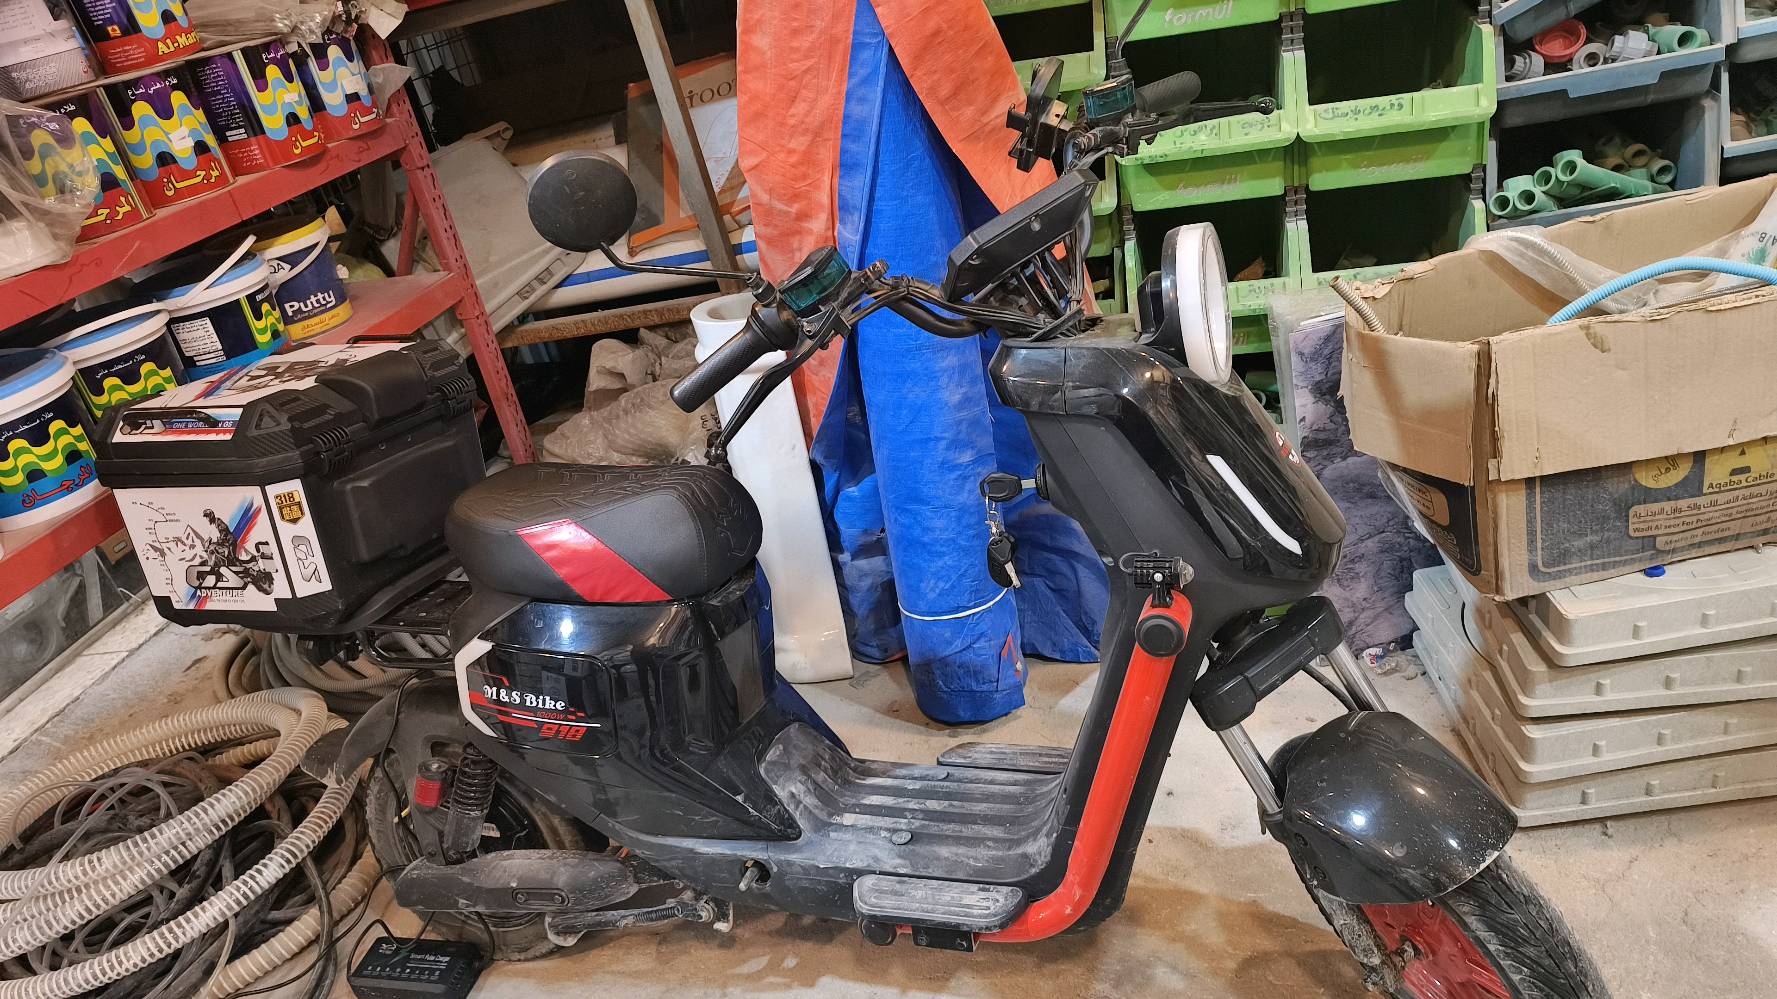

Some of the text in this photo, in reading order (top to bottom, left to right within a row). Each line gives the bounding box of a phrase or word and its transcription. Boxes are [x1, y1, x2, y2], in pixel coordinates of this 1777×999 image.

[165, 75, 178, 87] طلاء
[127, 84, 145, 99] لماع
[163, 160, 221, 197] المرجان
[284, 290, 335, 316] Putty
[21, 463, 94, 508] المرجان
[1706, 472, 1776, 491] Aqaba Cable
[275, 491, 296, 505] 318
[1632, 523, 1653, 534] Wadi
[1682, 518, 1695, 527] For
[197, 589, 245, 598] ADVENTURE
[523, 693, 566, 711] Bike
[536, 711, 566, 720] 1000W
[539, 723, 588, 741] 918
